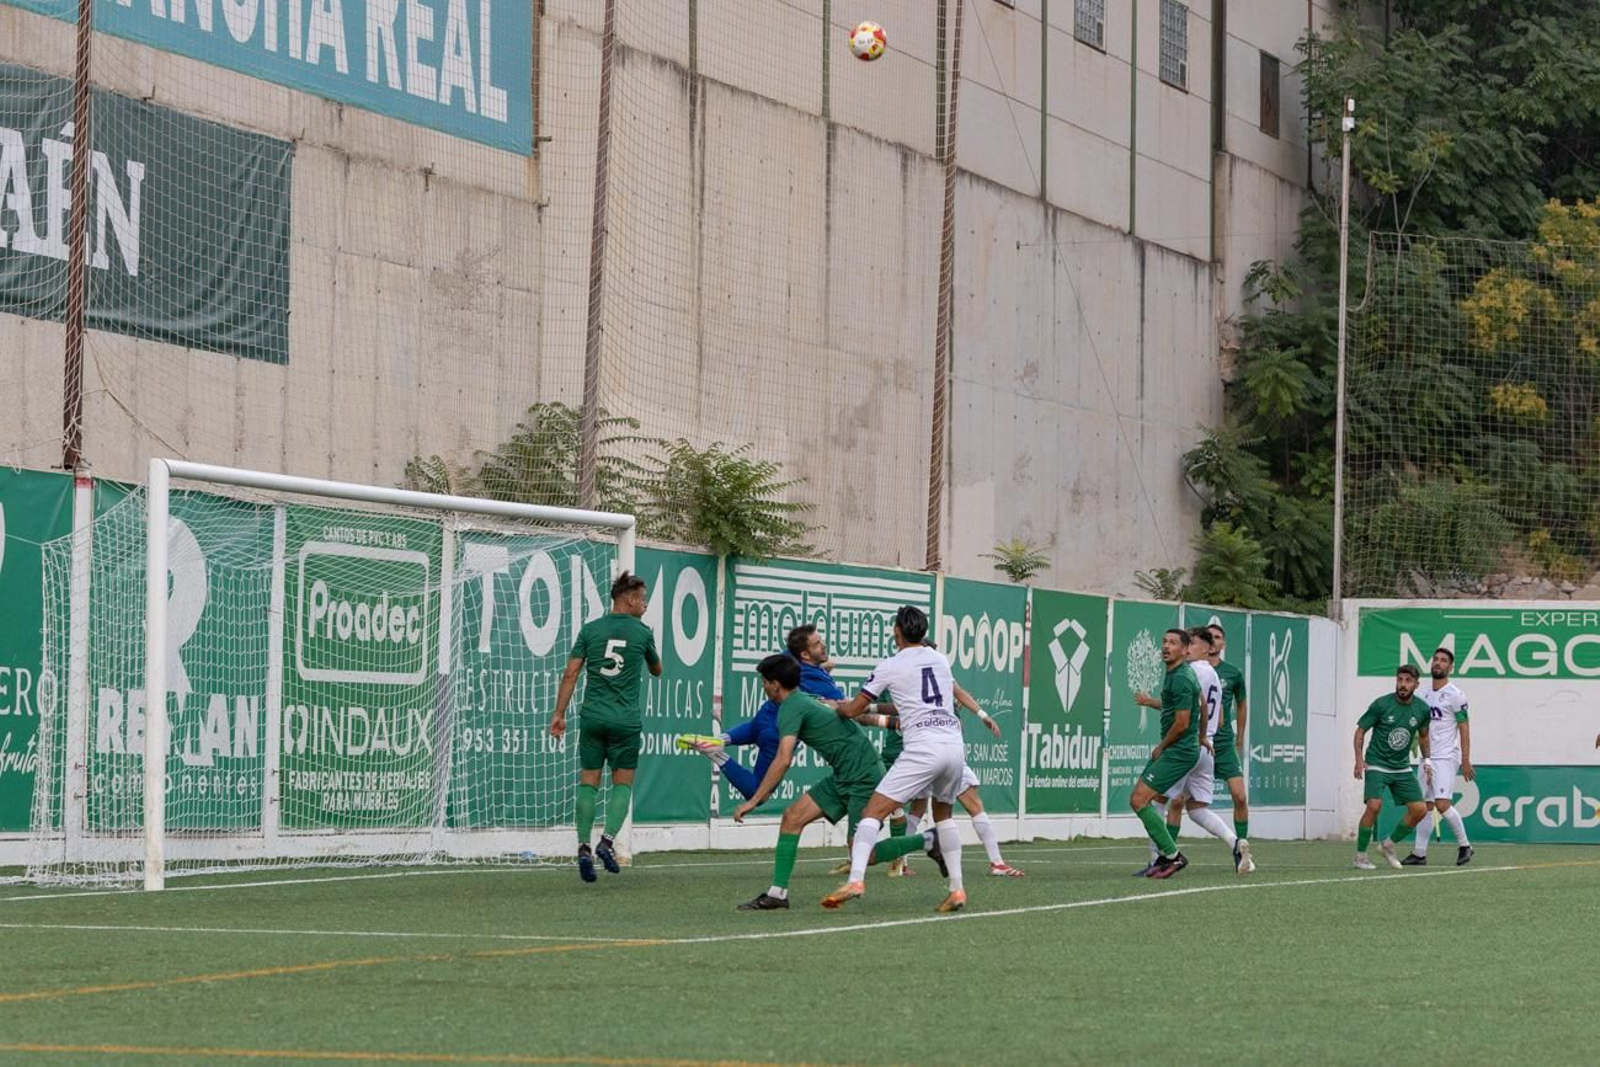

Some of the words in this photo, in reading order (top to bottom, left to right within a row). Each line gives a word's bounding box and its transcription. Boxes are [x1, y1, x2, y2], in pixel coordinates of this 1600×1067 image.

[366, 0, 508, 123] REAL
[309, 579, 420, 644] Proadec
[600, 639, 628, 677] 5
[921, 667, 943, 707] 4
[1206, 684, 1218, 720] 5
[312, 705, 435, 757] INDAUX
[463, 727, 494, 753] 953
[502, 728, 528, 753] 351
[974, 743, 988, 761] SAN
[989, 740, 1008, 762] JOSÉ
[1028, 723, 1101, 769] Tabidur
[94, 769, 258, 796] comonentes
[288, 771, 362, 790] FABRICANTES
[363, 772, 378, 790] DE
[781, 780, 794, 800] 20
[983, 768, 1013, 786] MARCOS
[1034, 774, 1051, 788] tienda
[1052, 774, 1067, 788] online
[1249, 772, 1306, 794] coatings
[322, 791, 351, 811] PARA
[352, 792, 399, 811] MUEBLES
